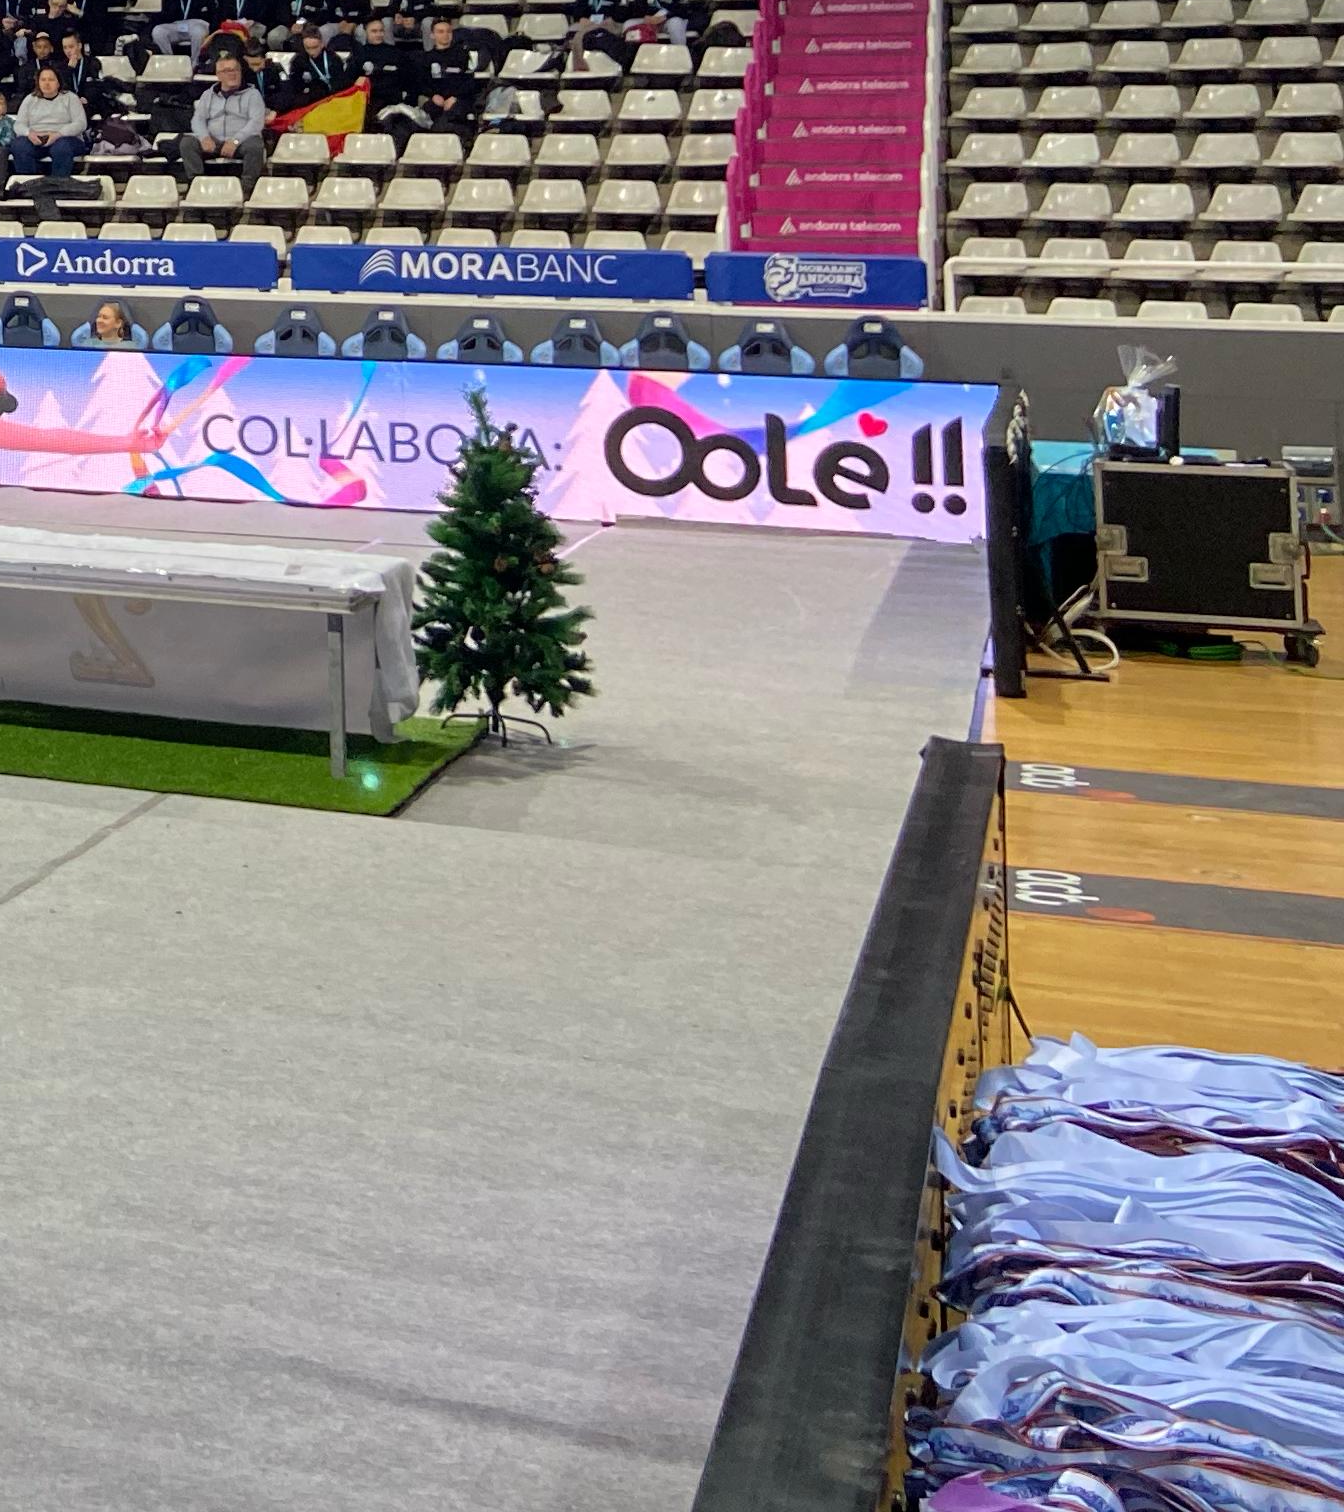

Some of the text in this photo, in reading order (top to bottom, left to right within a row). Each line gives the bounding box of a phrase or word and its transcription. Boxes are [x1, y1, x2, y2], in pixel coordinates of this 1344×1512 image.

[799, 219, 902, 232] andorra telecom
[52, 248, 175, 277] Andorra
[401, 251, 619, 285] MORABANC
[798, 273, 864, 287] ANDORRA
[201, 413, 563, 472] COL·LABOA:
